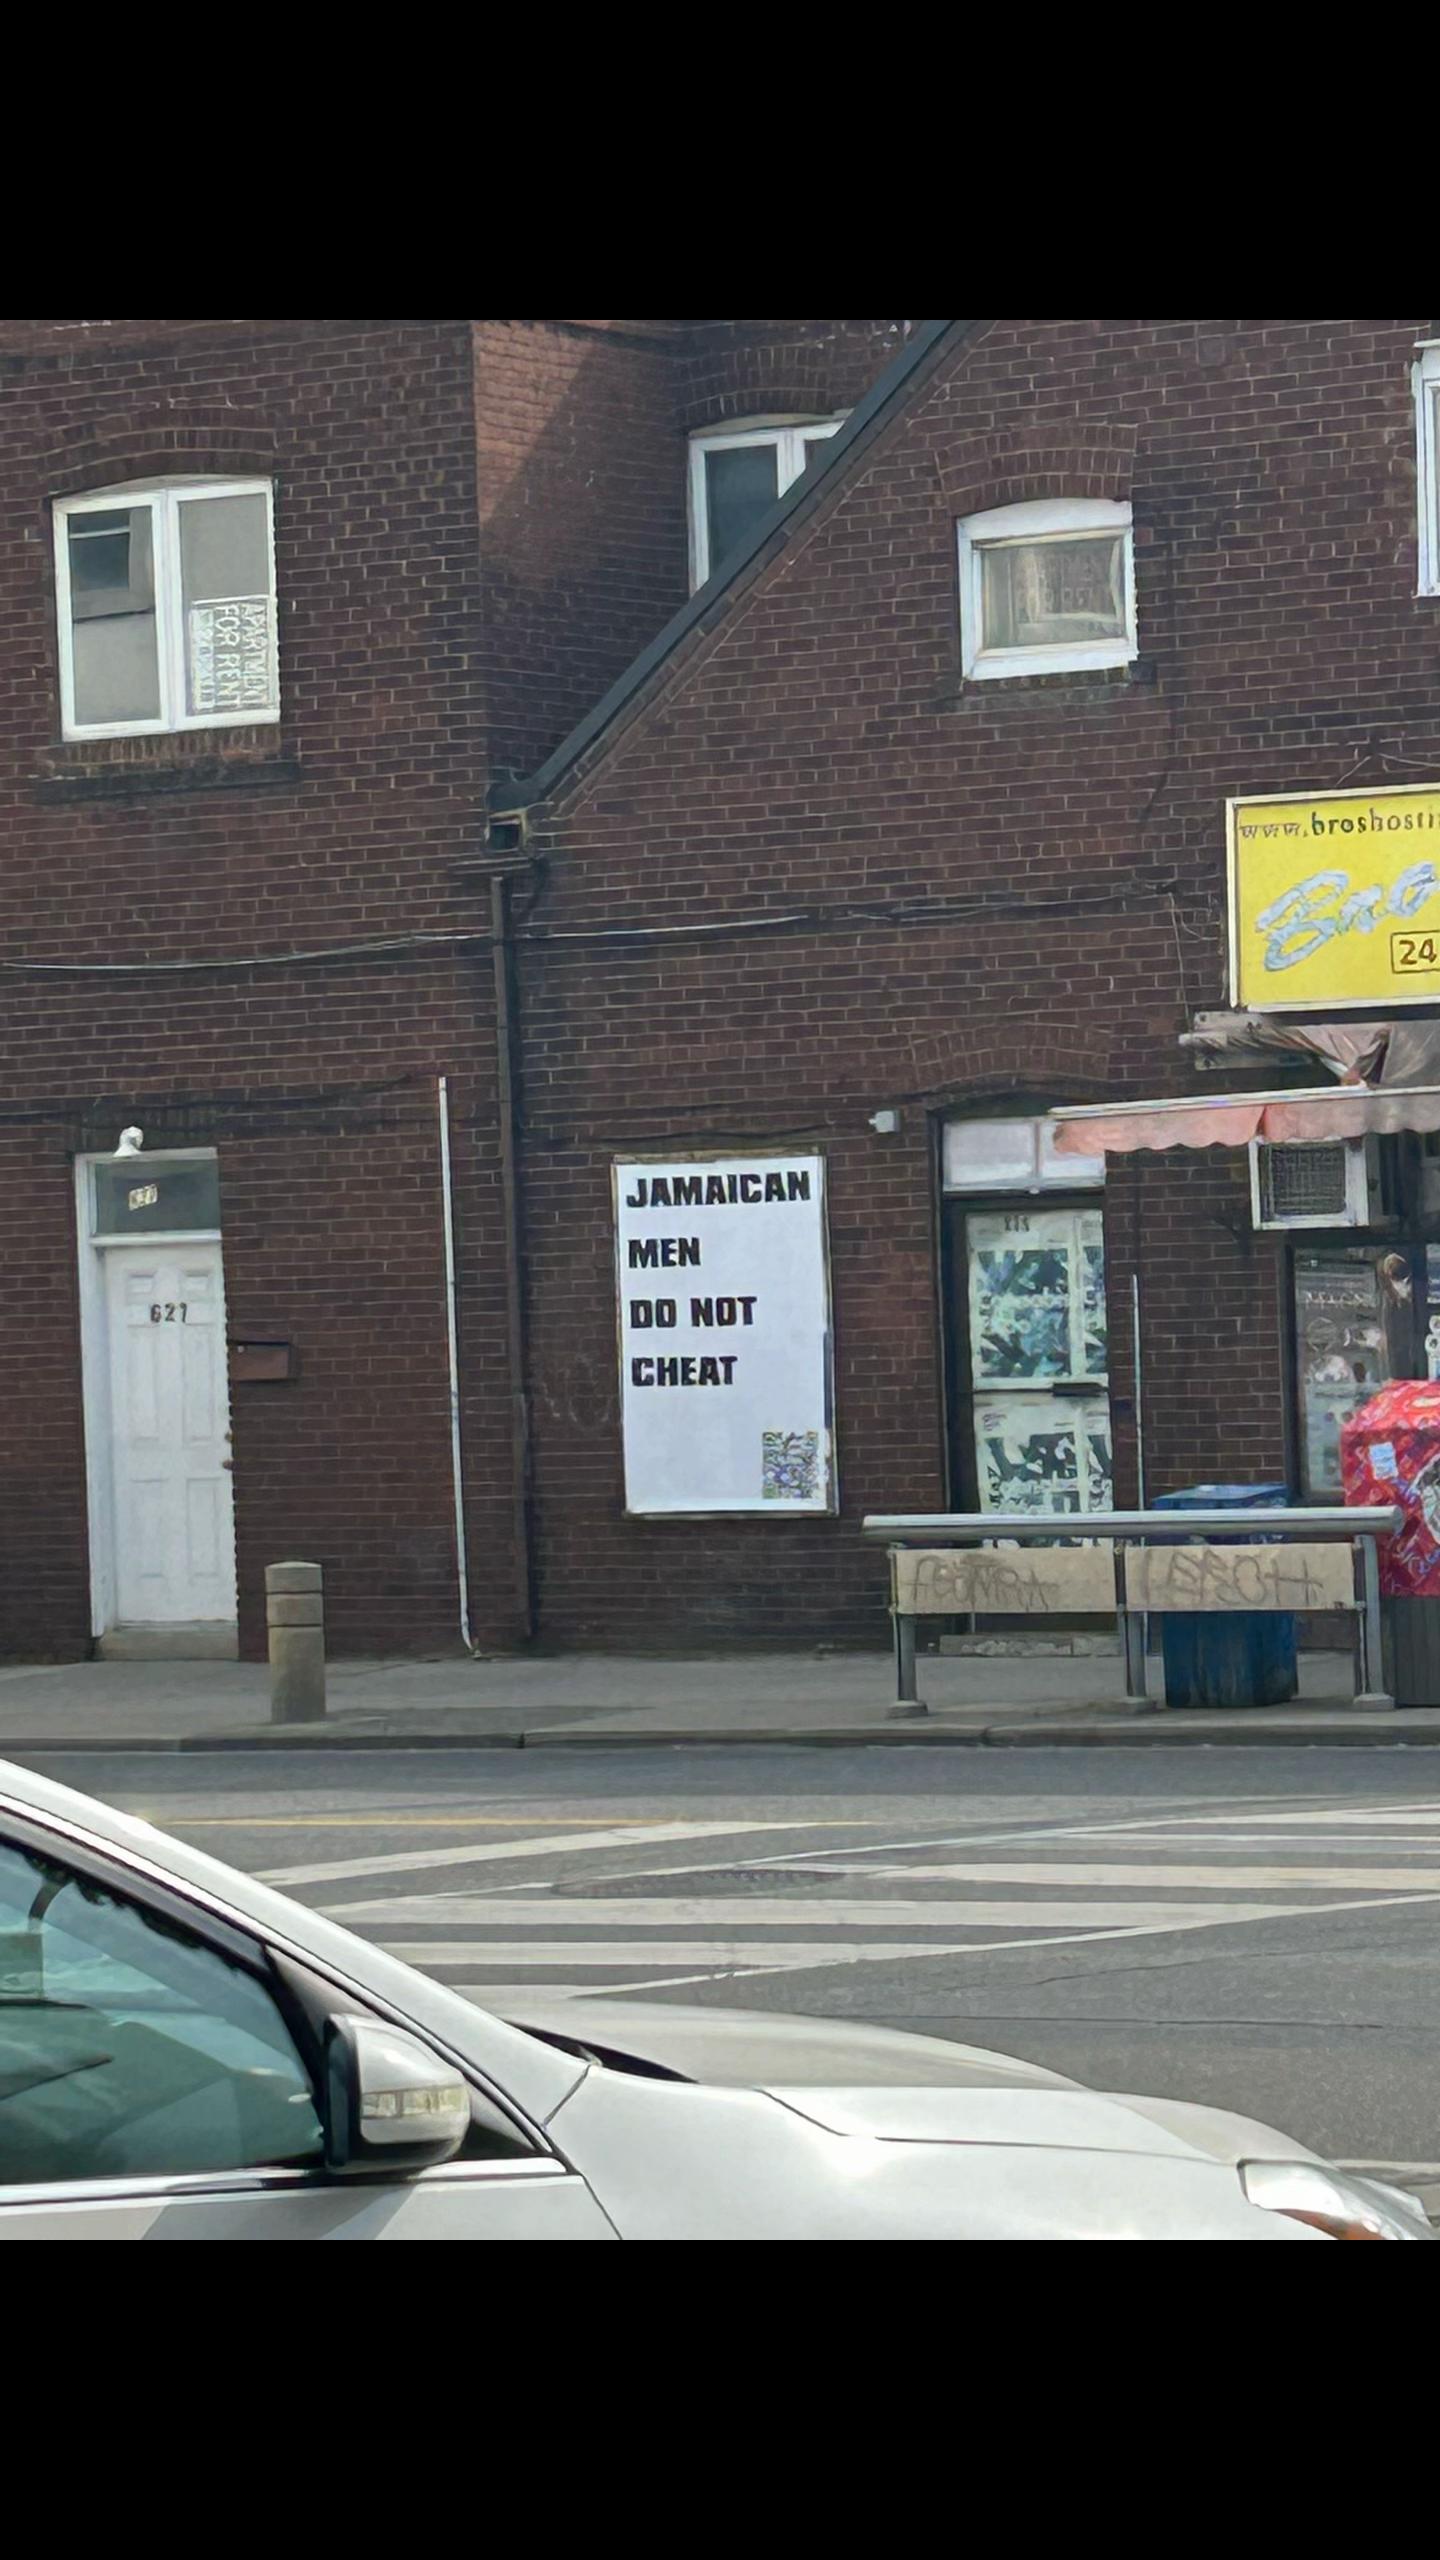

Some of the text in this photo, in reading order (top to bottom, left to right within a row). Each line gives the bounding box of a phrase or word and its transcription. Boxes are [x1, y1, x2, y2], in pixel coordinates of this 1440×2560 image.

[215, 604, 241, 706] FOR RENT
[1240, 806, 1440, 839] www.broshosti
[1399, 938, 1437, 965] 24
[626, 1170, 811, 1208] JAMAICAN
[628, 1236, 701, 1269] MEN
[150, 1302, 188, 1324] 627
[630, 1296, 758, 1329] DO NOT
[631, 1355, 738, 1387] CHEAT
